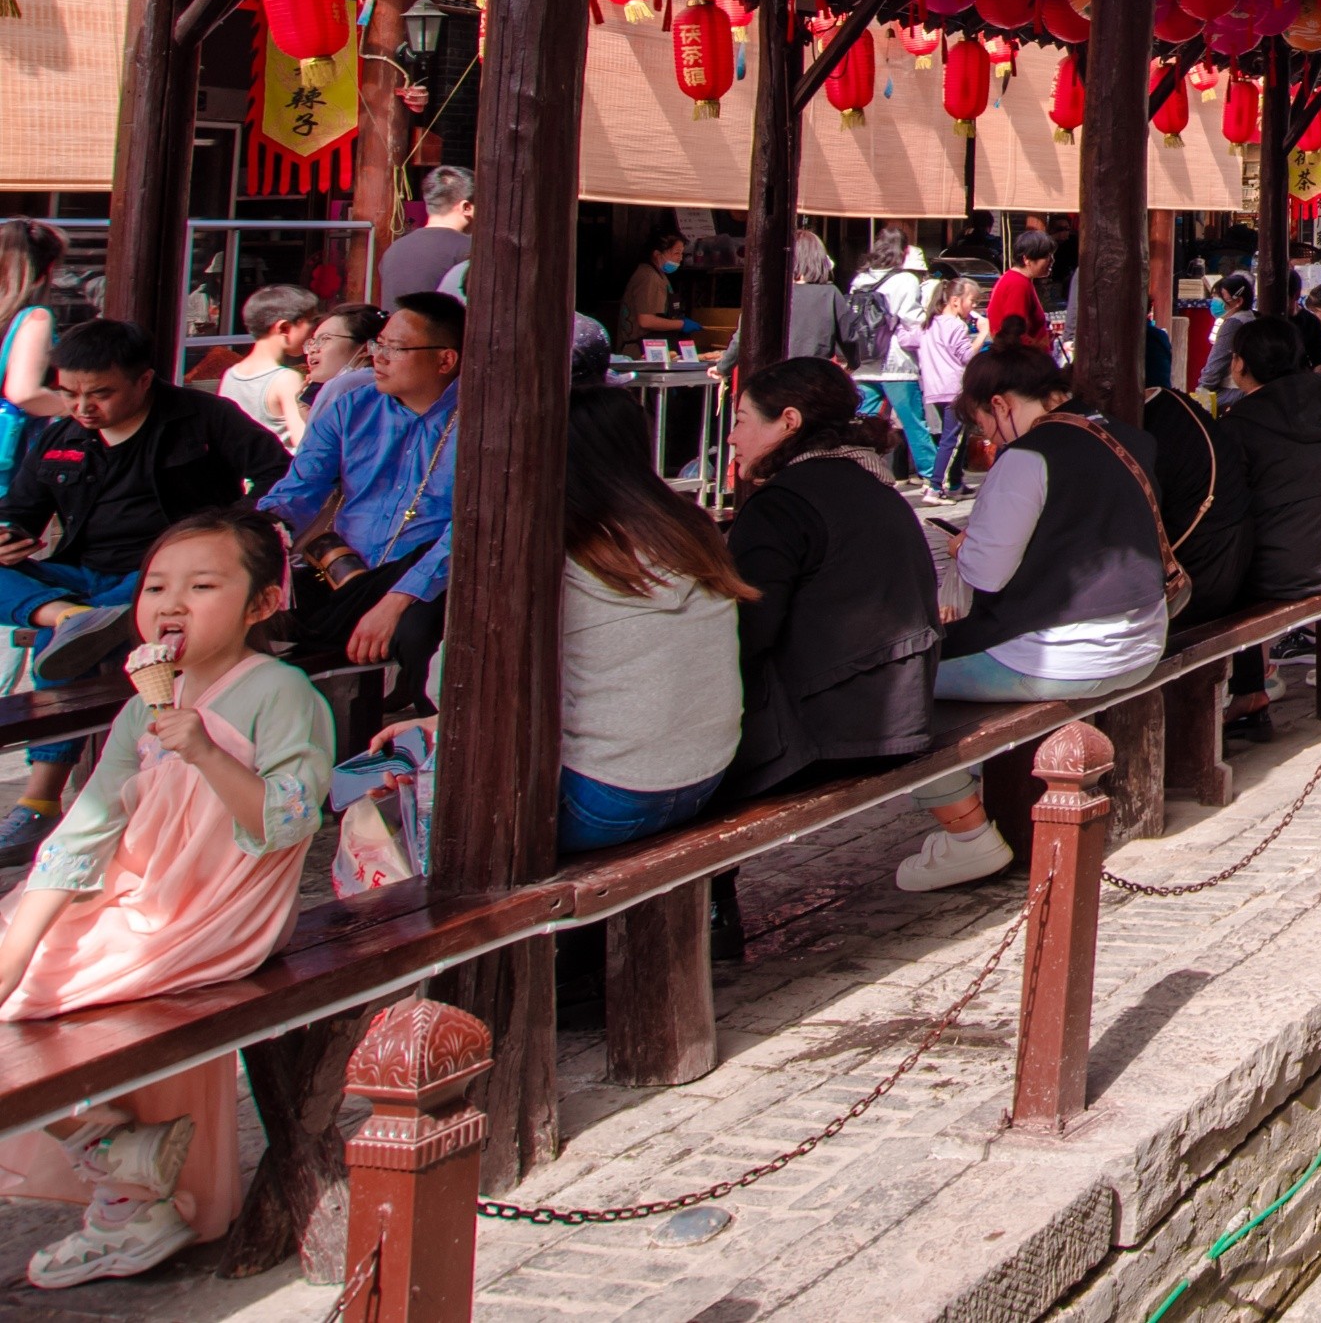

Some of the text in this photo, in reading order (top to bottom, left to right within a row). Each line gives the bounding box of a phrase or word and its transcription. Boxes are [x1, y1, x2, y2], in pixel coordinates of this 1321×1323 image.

[679, 24, 707, 88] 茯茶镇
[285, 68, 327, 137] 辣子
